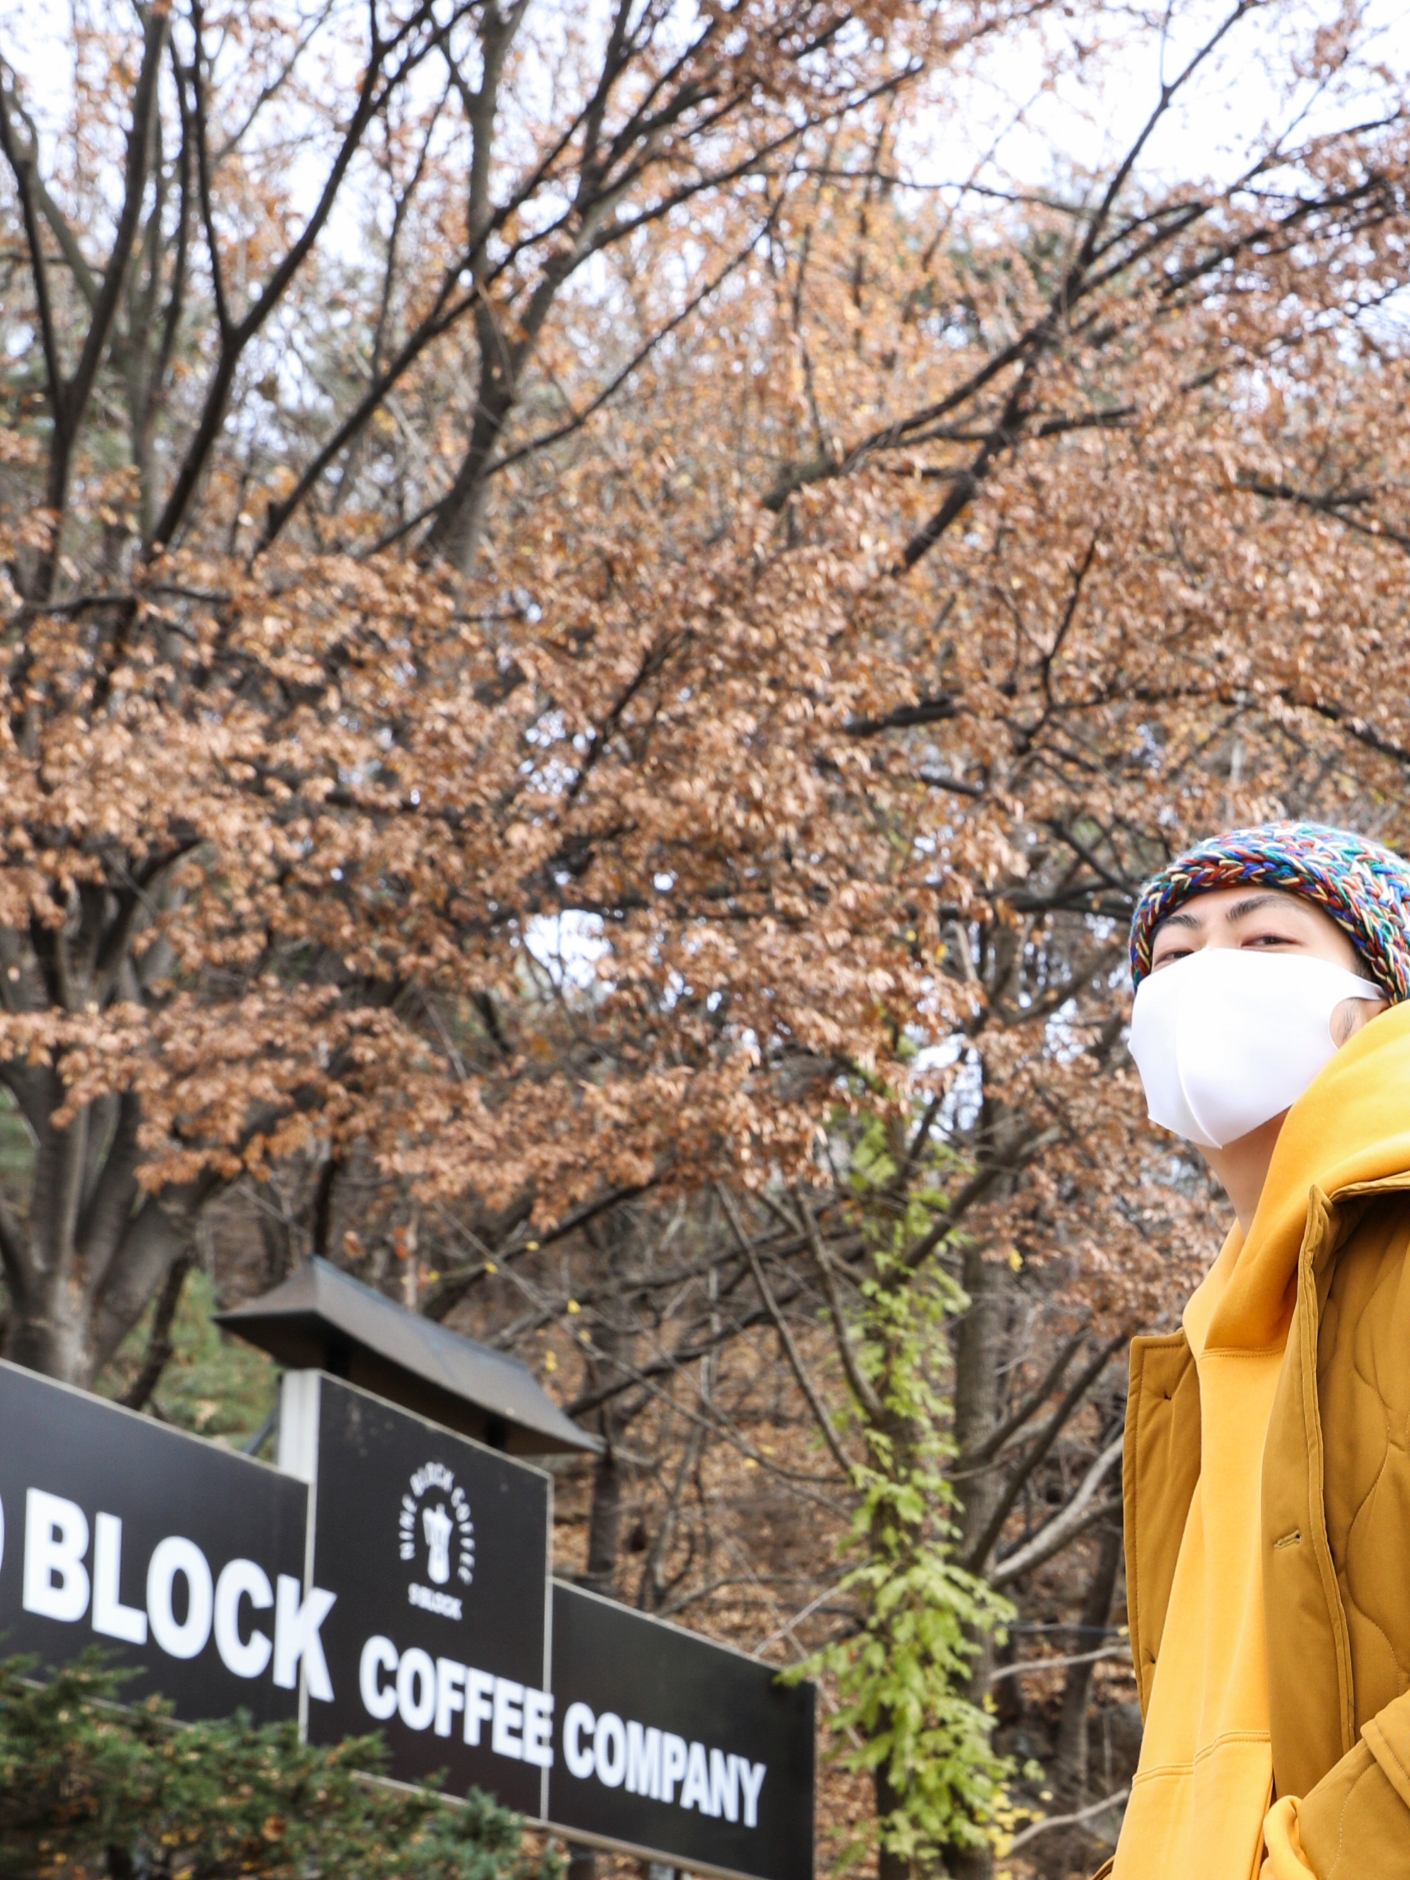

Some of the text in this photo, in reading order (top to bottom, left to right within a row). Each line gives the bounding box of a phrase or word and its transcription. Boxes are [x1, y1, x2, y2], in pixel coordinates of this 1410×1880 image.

[22, 1486, 338, 1703] BLOCK
[359, 1635, 555, 1767] COFFEE
[563, 1702, 767, 1828] COMPANY
